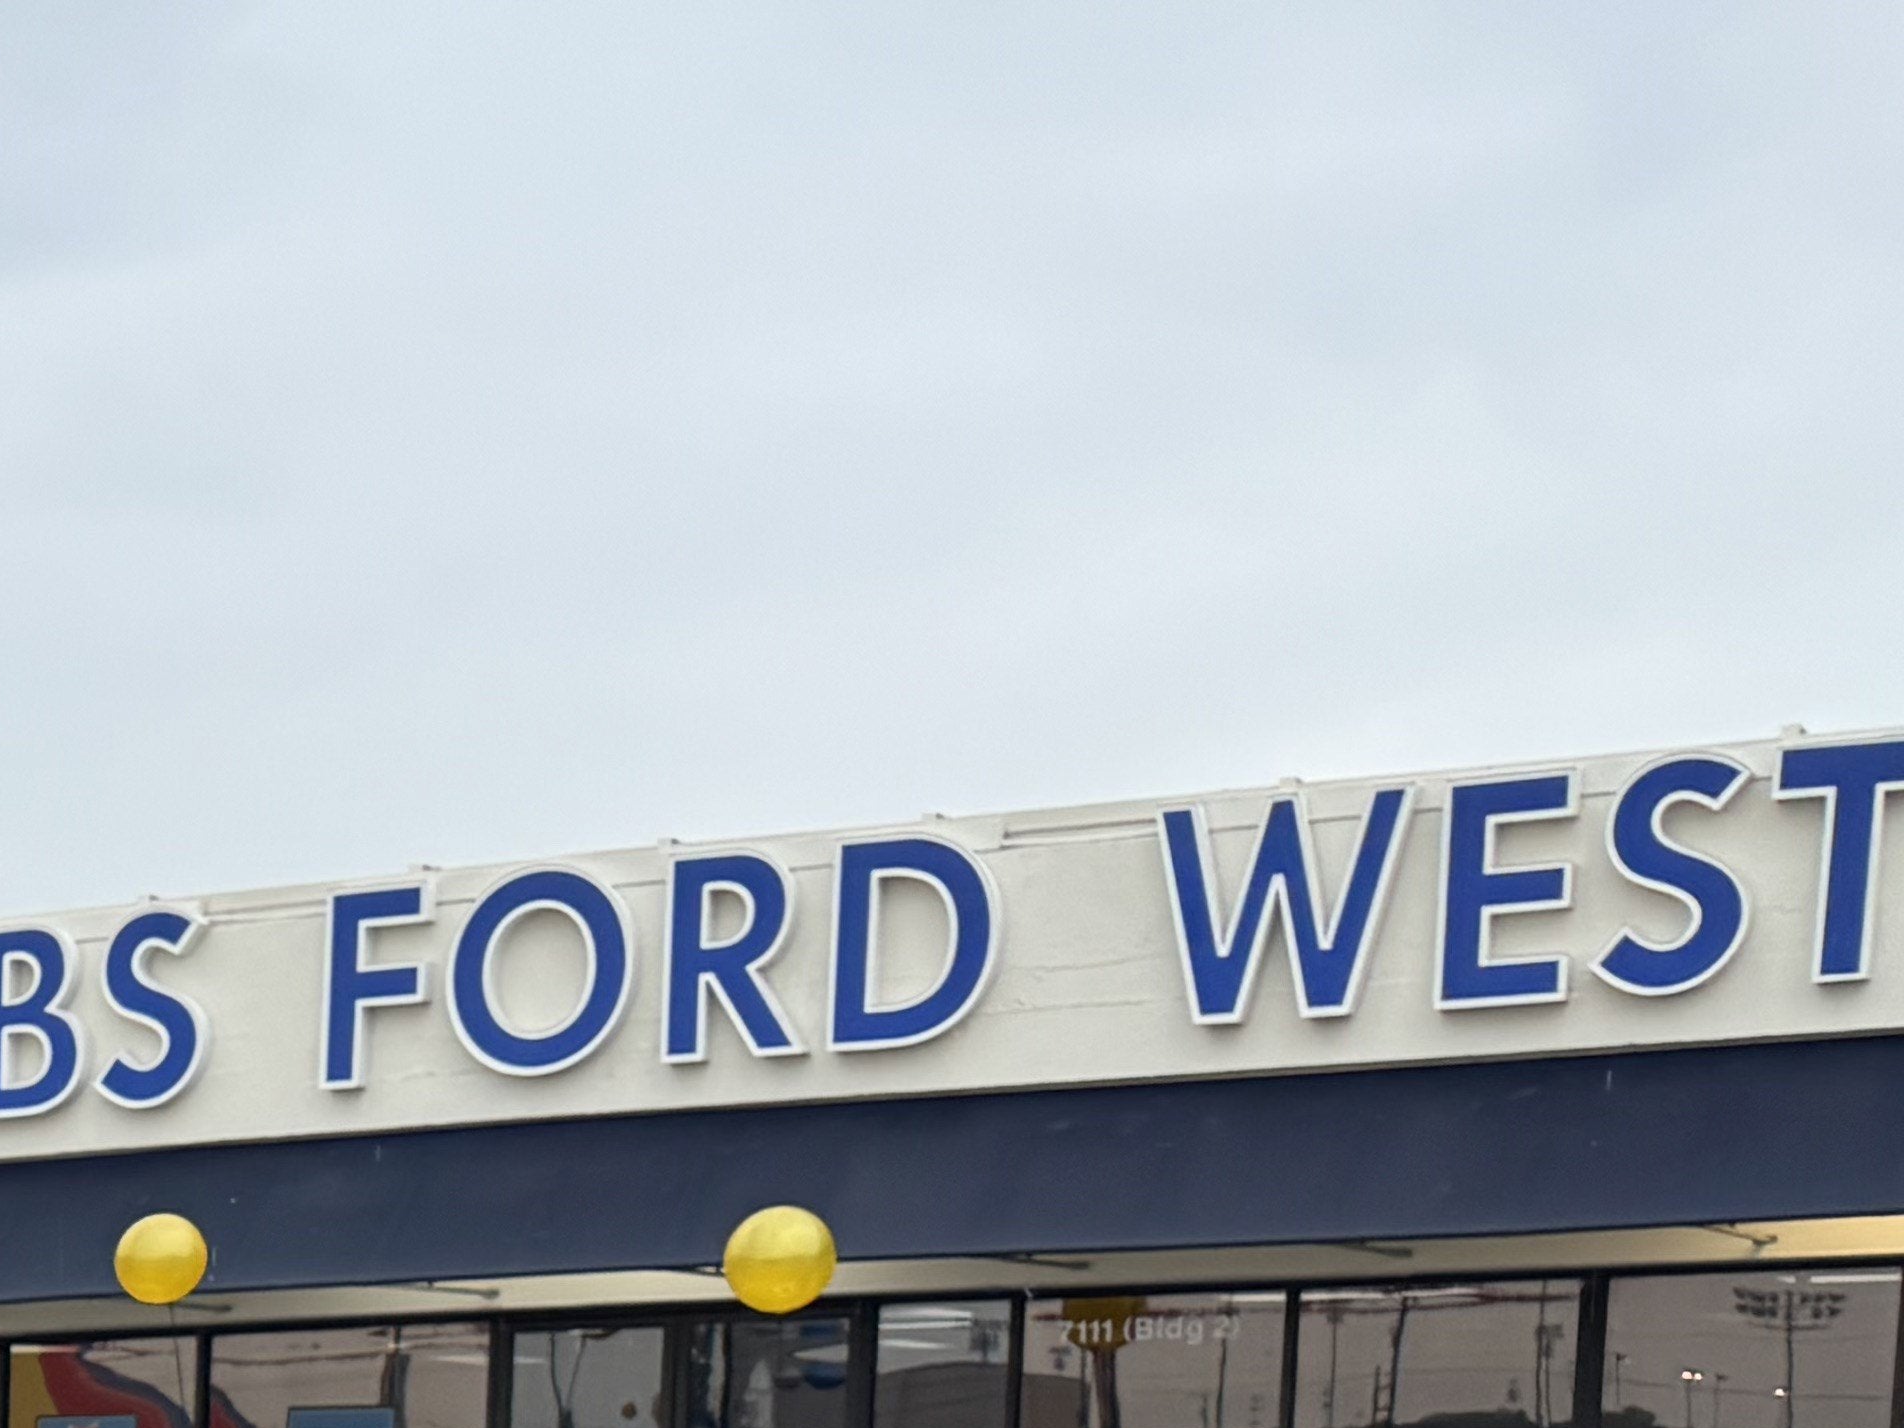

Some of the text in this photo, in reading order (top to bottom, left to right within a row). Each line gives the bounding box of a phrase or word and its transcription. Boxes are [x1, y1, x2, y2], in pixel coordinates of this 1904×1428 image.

[319, 832, 1002, 1090] FORD
[1157, 738, 1904, 1026] WEST
[1058, 1314, 1240, 1346] 7111 (Bldg 2)
